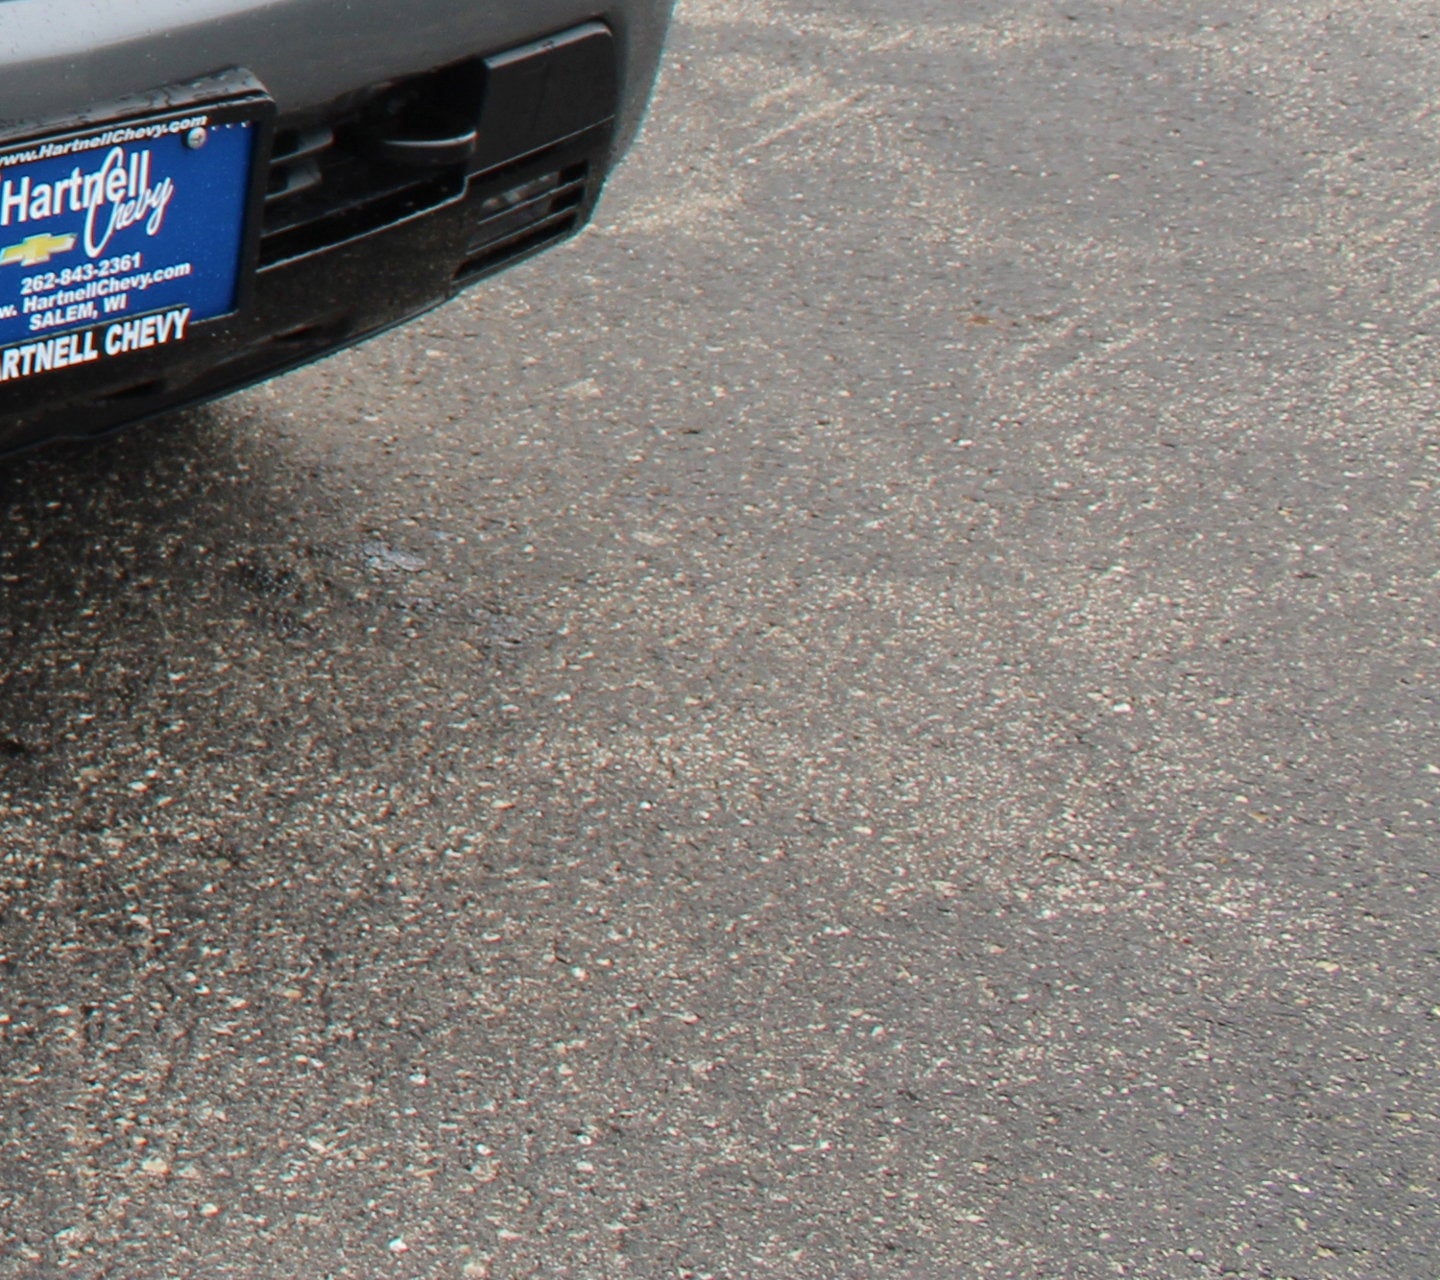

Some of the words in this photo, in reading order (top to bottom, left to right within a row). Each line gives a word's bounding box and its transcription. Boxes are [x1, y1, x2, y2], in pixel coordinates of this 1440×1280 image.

[0, 149, 150, 226] Hartnell
[84, 146, 173, 258] Chevy
[21, 252, 142, 295] 262-843-2361
[23, 262, 191, 314] HartnellChevy.com
[29, 301, 98, 330] SALEM,
[103, 293, 126, 313] WI
[104, 308, 191, 356] CHEVY
